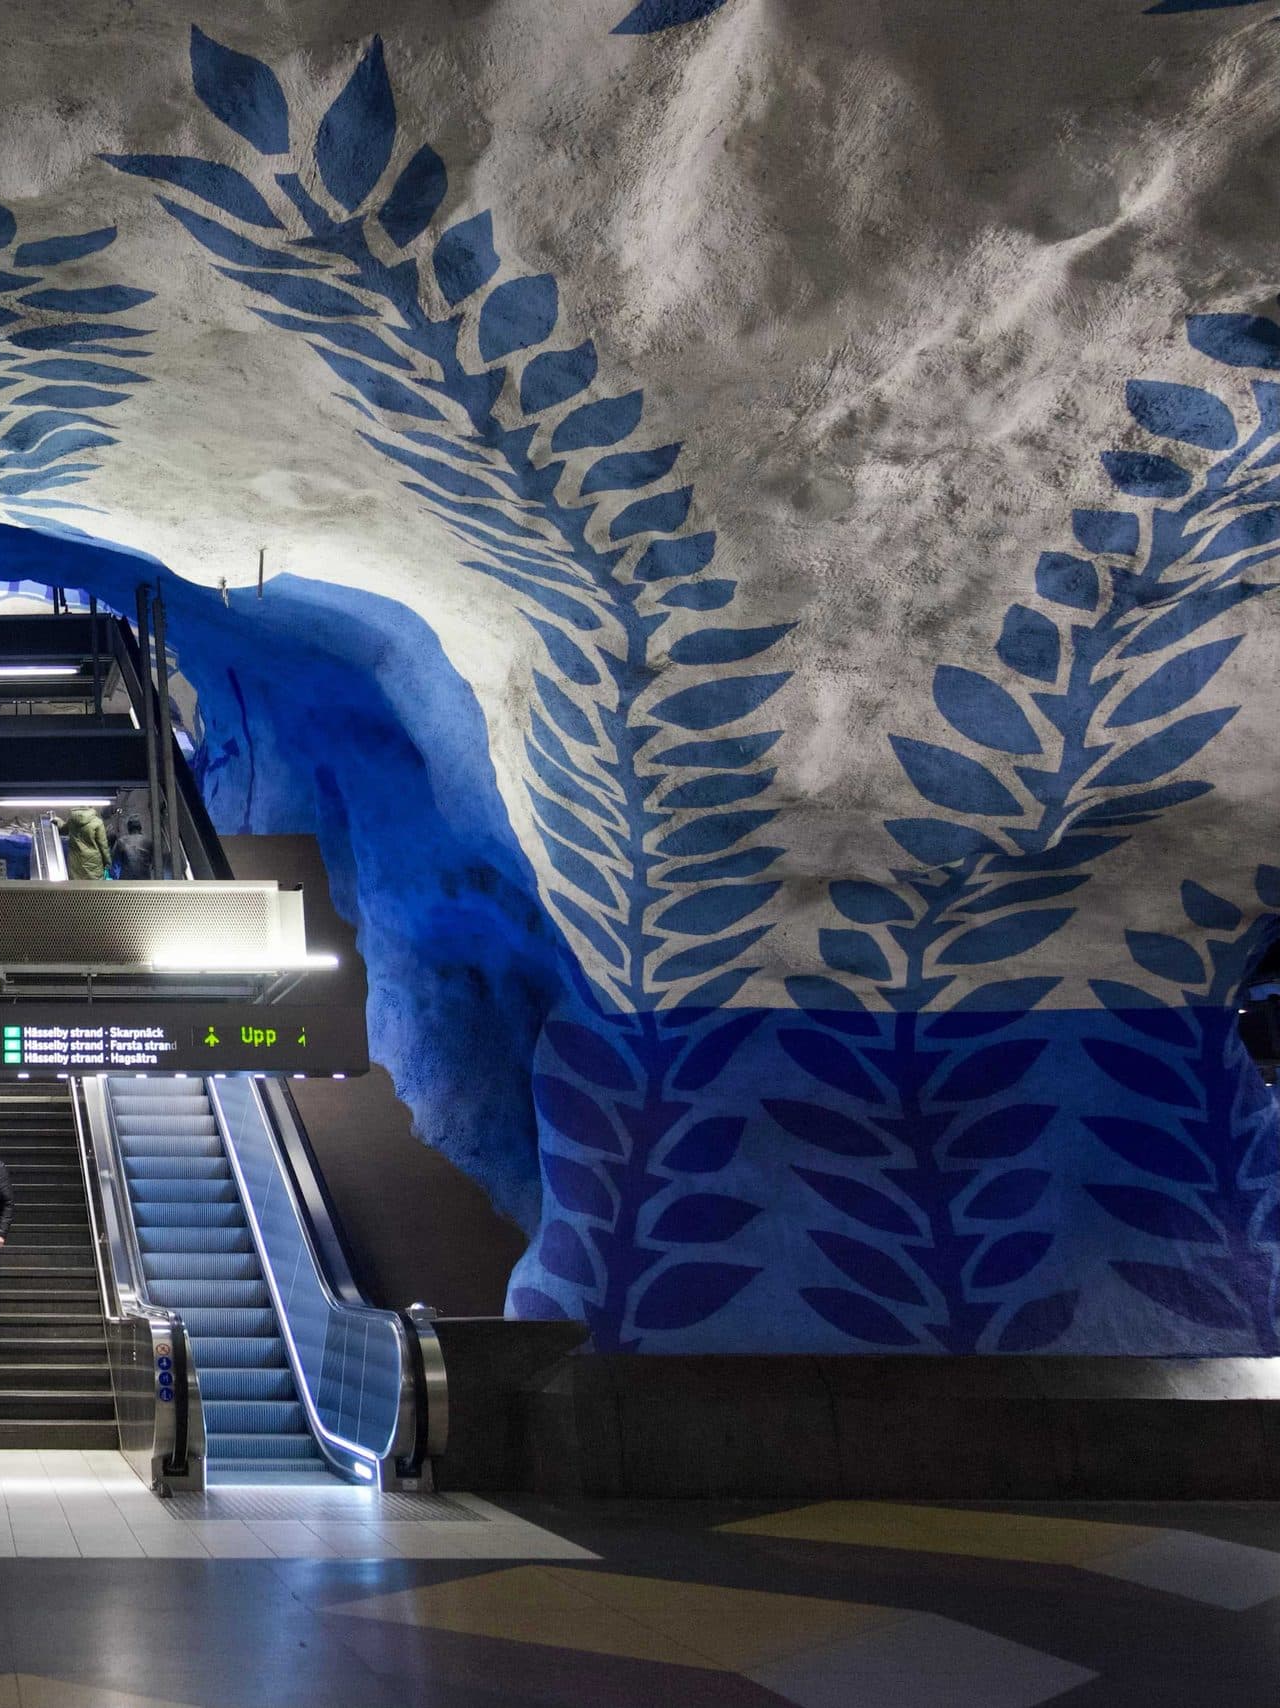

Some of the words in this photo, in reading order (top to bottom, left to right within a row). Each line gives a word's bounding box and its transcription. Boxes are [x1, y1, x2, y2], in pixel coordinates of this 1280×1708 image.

[24, 1027, 68, 1039] Hässelby
[70, 1027, 103, 1038] strand
[110, 1027, 164, 1039] Skarpnäck
[240, 1026, 276, 1047] Upp
[24, 1040, 68, 1052] Hässelby
[70, 1040, 104, 1050] strand
[110, 1040, 143, 1050] Farsta
[24, 1052, 69, 1065] Hässelby
[70, 1052, 104, 1063] strand
[111, 1052, 157, 1065] Hagsätra
